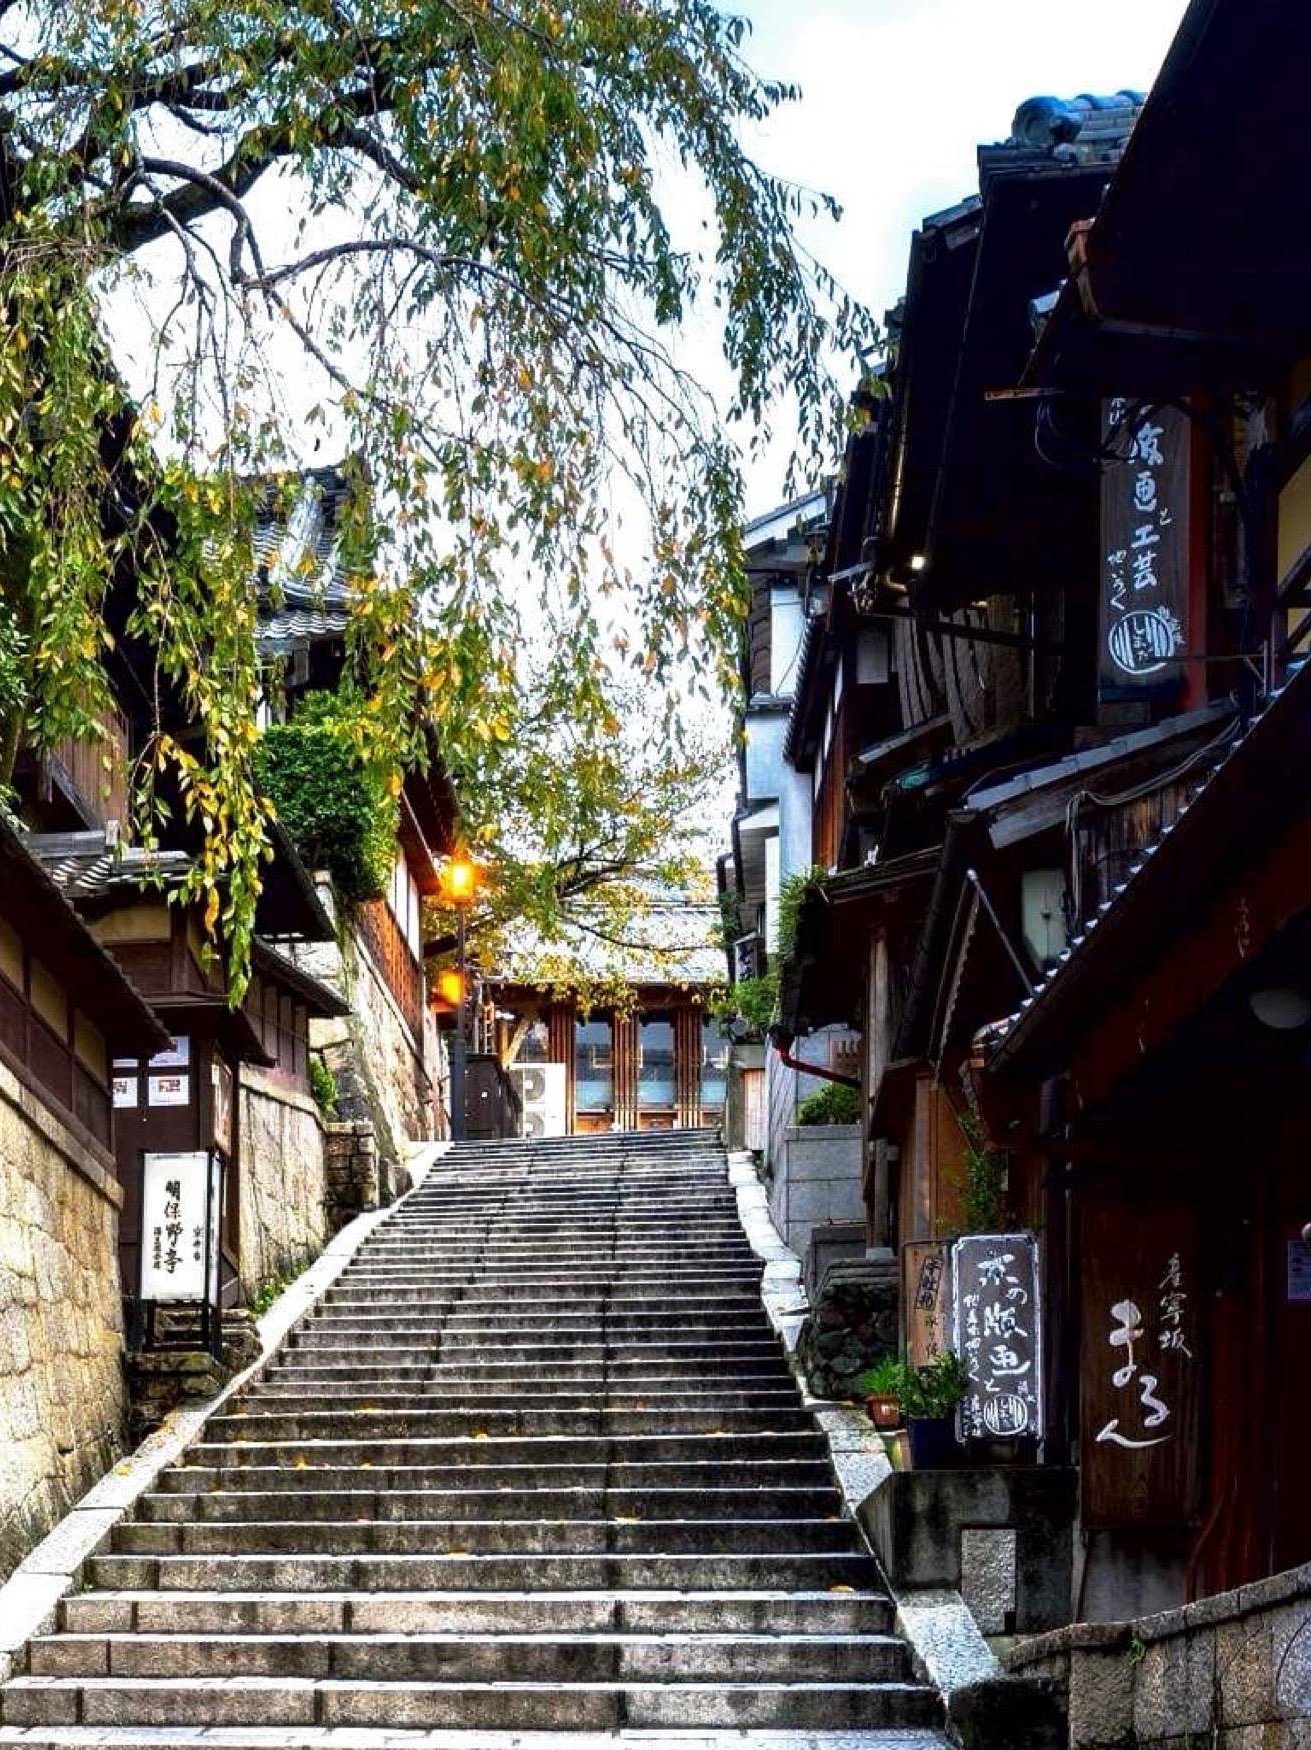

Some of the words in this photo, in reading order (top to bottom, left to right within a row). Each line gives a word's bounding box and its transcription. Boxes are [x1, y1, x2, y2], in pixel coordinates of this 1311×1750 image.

[164, 1180, 183, 1274] 明保野亭
[1158, 1252, 1192, 1358] 産寧坂
